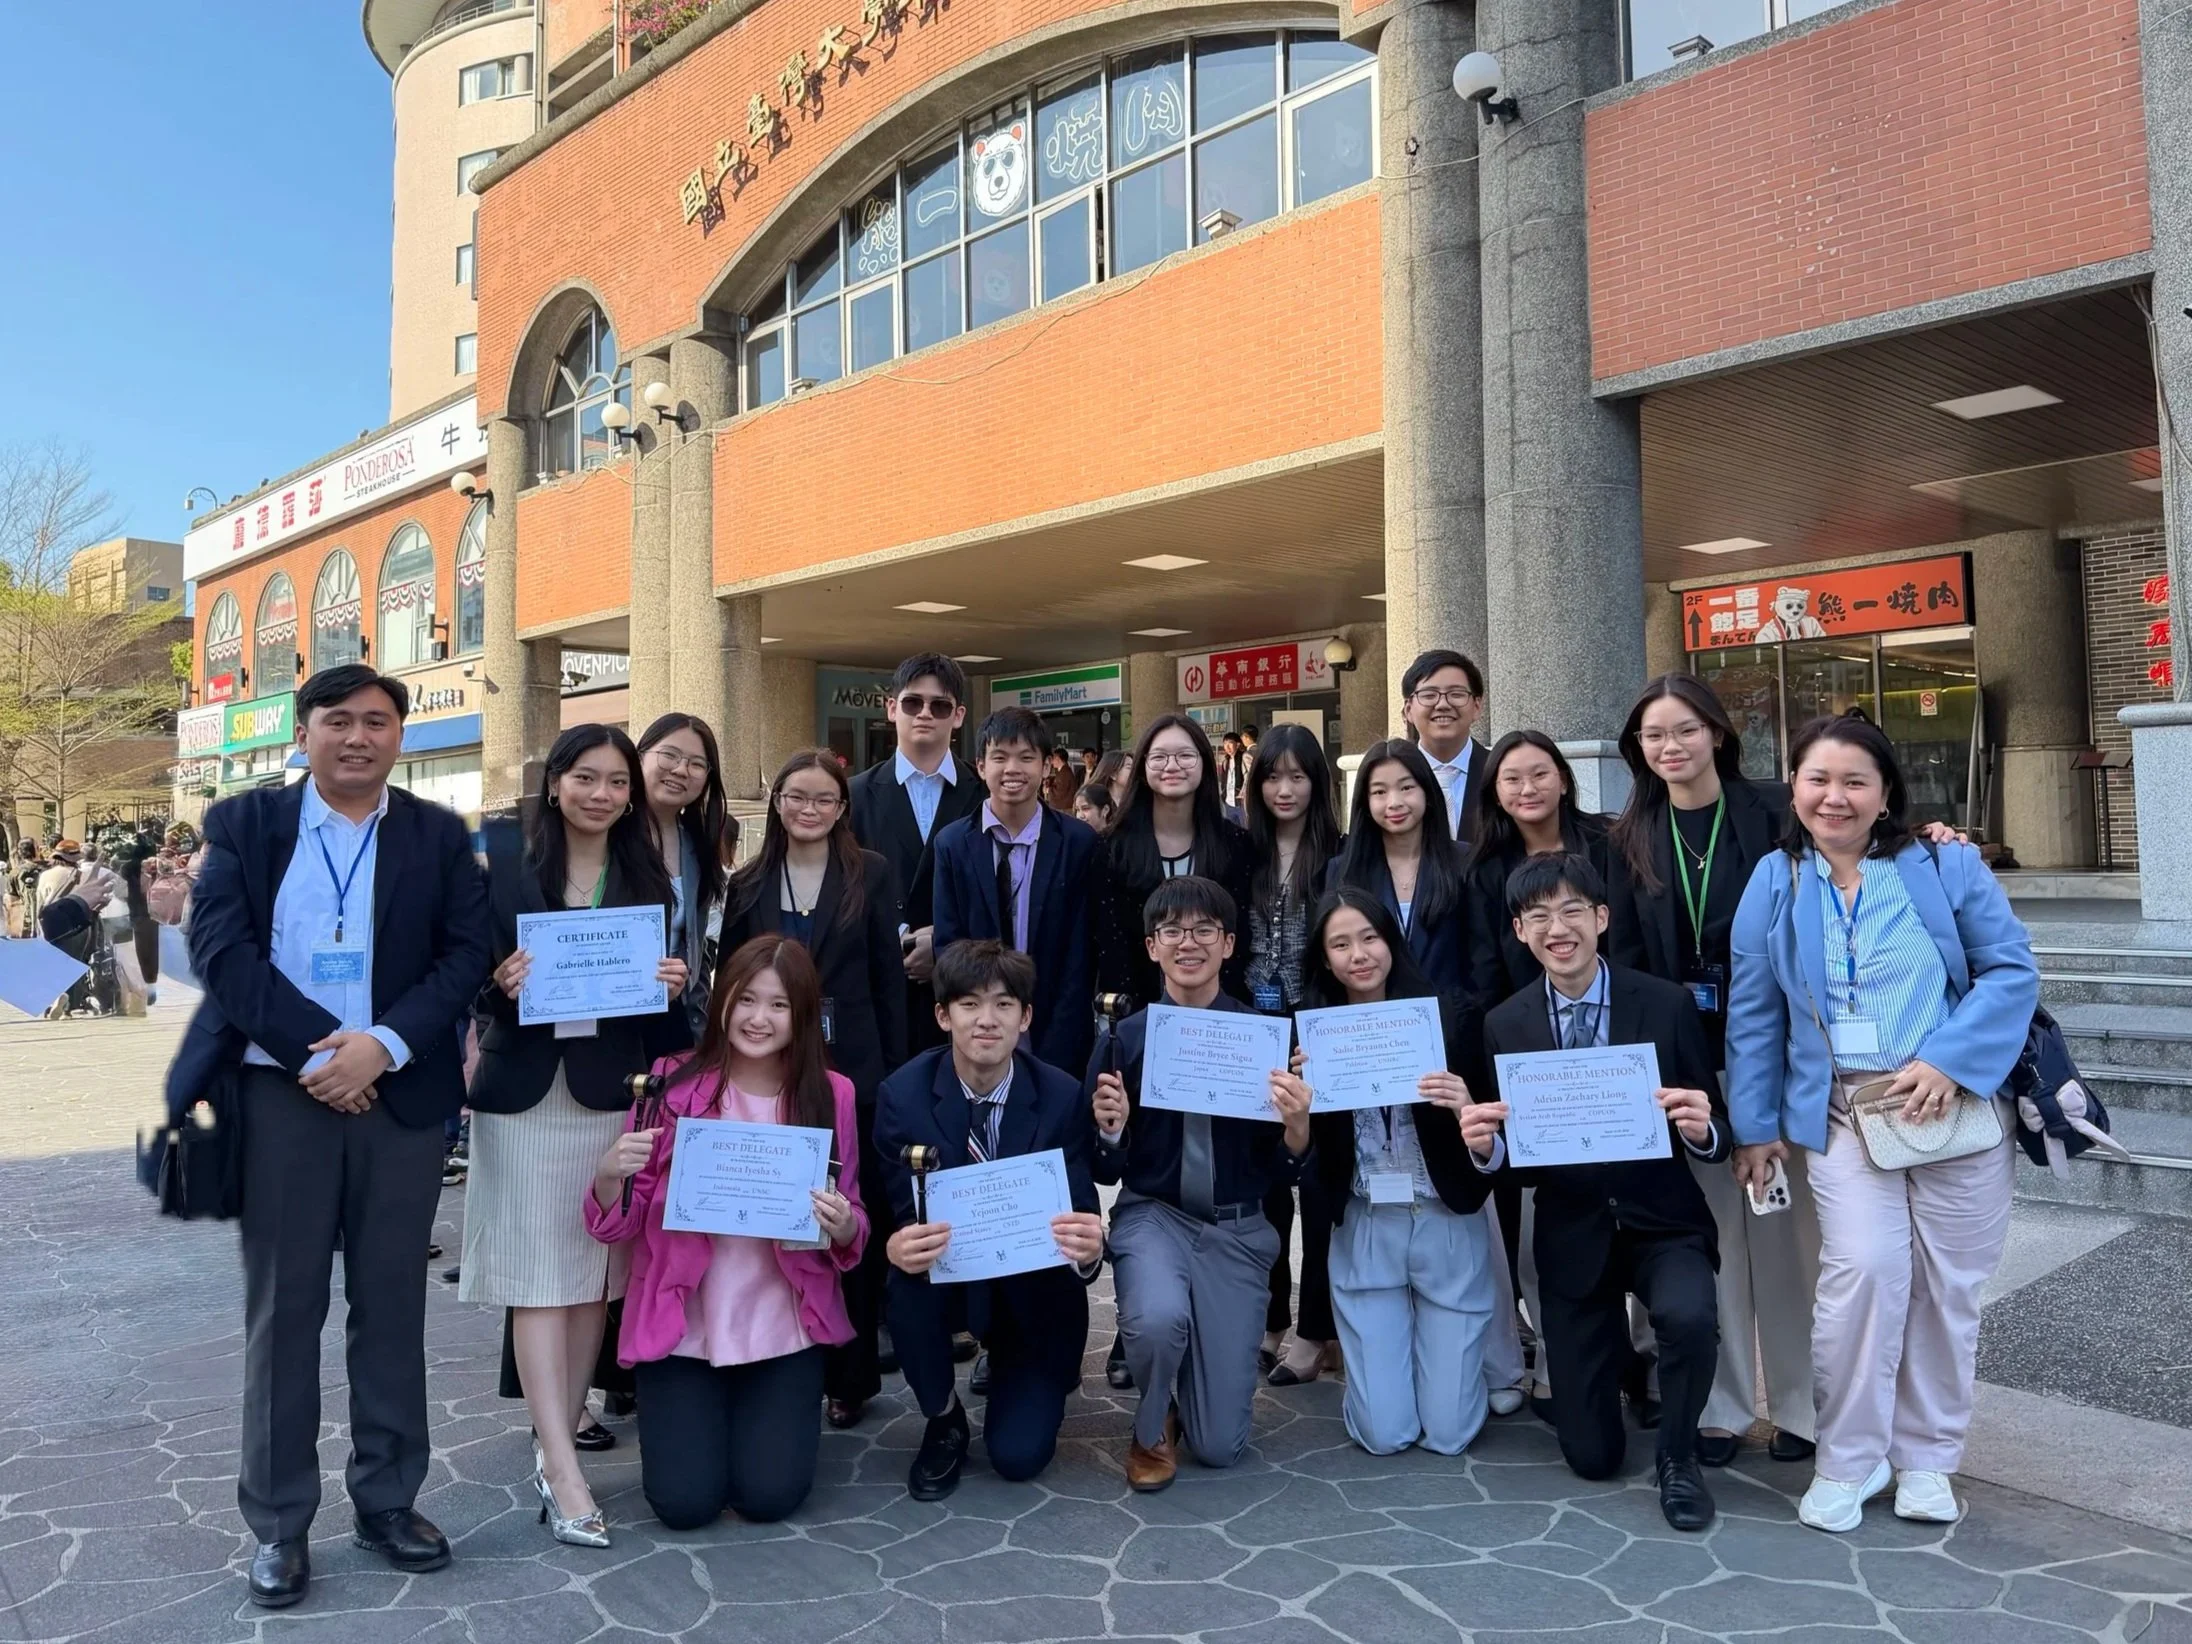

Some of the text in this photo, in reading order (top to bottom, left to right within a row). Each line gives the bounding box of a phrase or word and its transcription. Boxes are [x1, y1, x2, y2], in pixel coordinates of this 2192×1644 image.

[680, 0, 922, 225] 國立臺灣大學
[344, 437, 415, 492] PONDEROSA
[356, 473, 401, 498] STEAKHOUSE
[1686, 595, 1703, 606] 2F
[561, 651, 630, 681] ÖVENPIC
[1215, 653, 1292, 678] 華南銀行
[1214, 672, 1292, 693] 自動化服務區
[1034, 686, 1087, 703] FamilyMart
[230, 703, 285, 741] SUBWAY
[557, 930, 629, 943] CERTIFICATE
[556, 958, 595, 970] Gabrielle
[1180, 1027, 1204, 1037] BEST
[1205, 1029, 1254, 1042] DELEGATE
[1315, 1018, 1421, 1037] HONORABLE MENTION
[1389, 1039, 1410, 1048] Chen
[1177, 1047, 1206, 1058] Justine
[1207, 1050, 1229, 1061] Bryce
[1517, 1067, 1636, 1084] HONORABLE MENTION
[1533, 1090, 1628, 1104] Adrian Zachary Liong
[712, 1141, 792, 1156] BEST DELEGATE
[716, 1163, 743, 1173] Bianca
[772, 1169, 782, 1177] Sy
[952, 1186, 977, 1199] BEST
[979, 1177, 1031, 1193] DELEGATE
[971, 1202, 1019, 1219] Yejoon Cho
